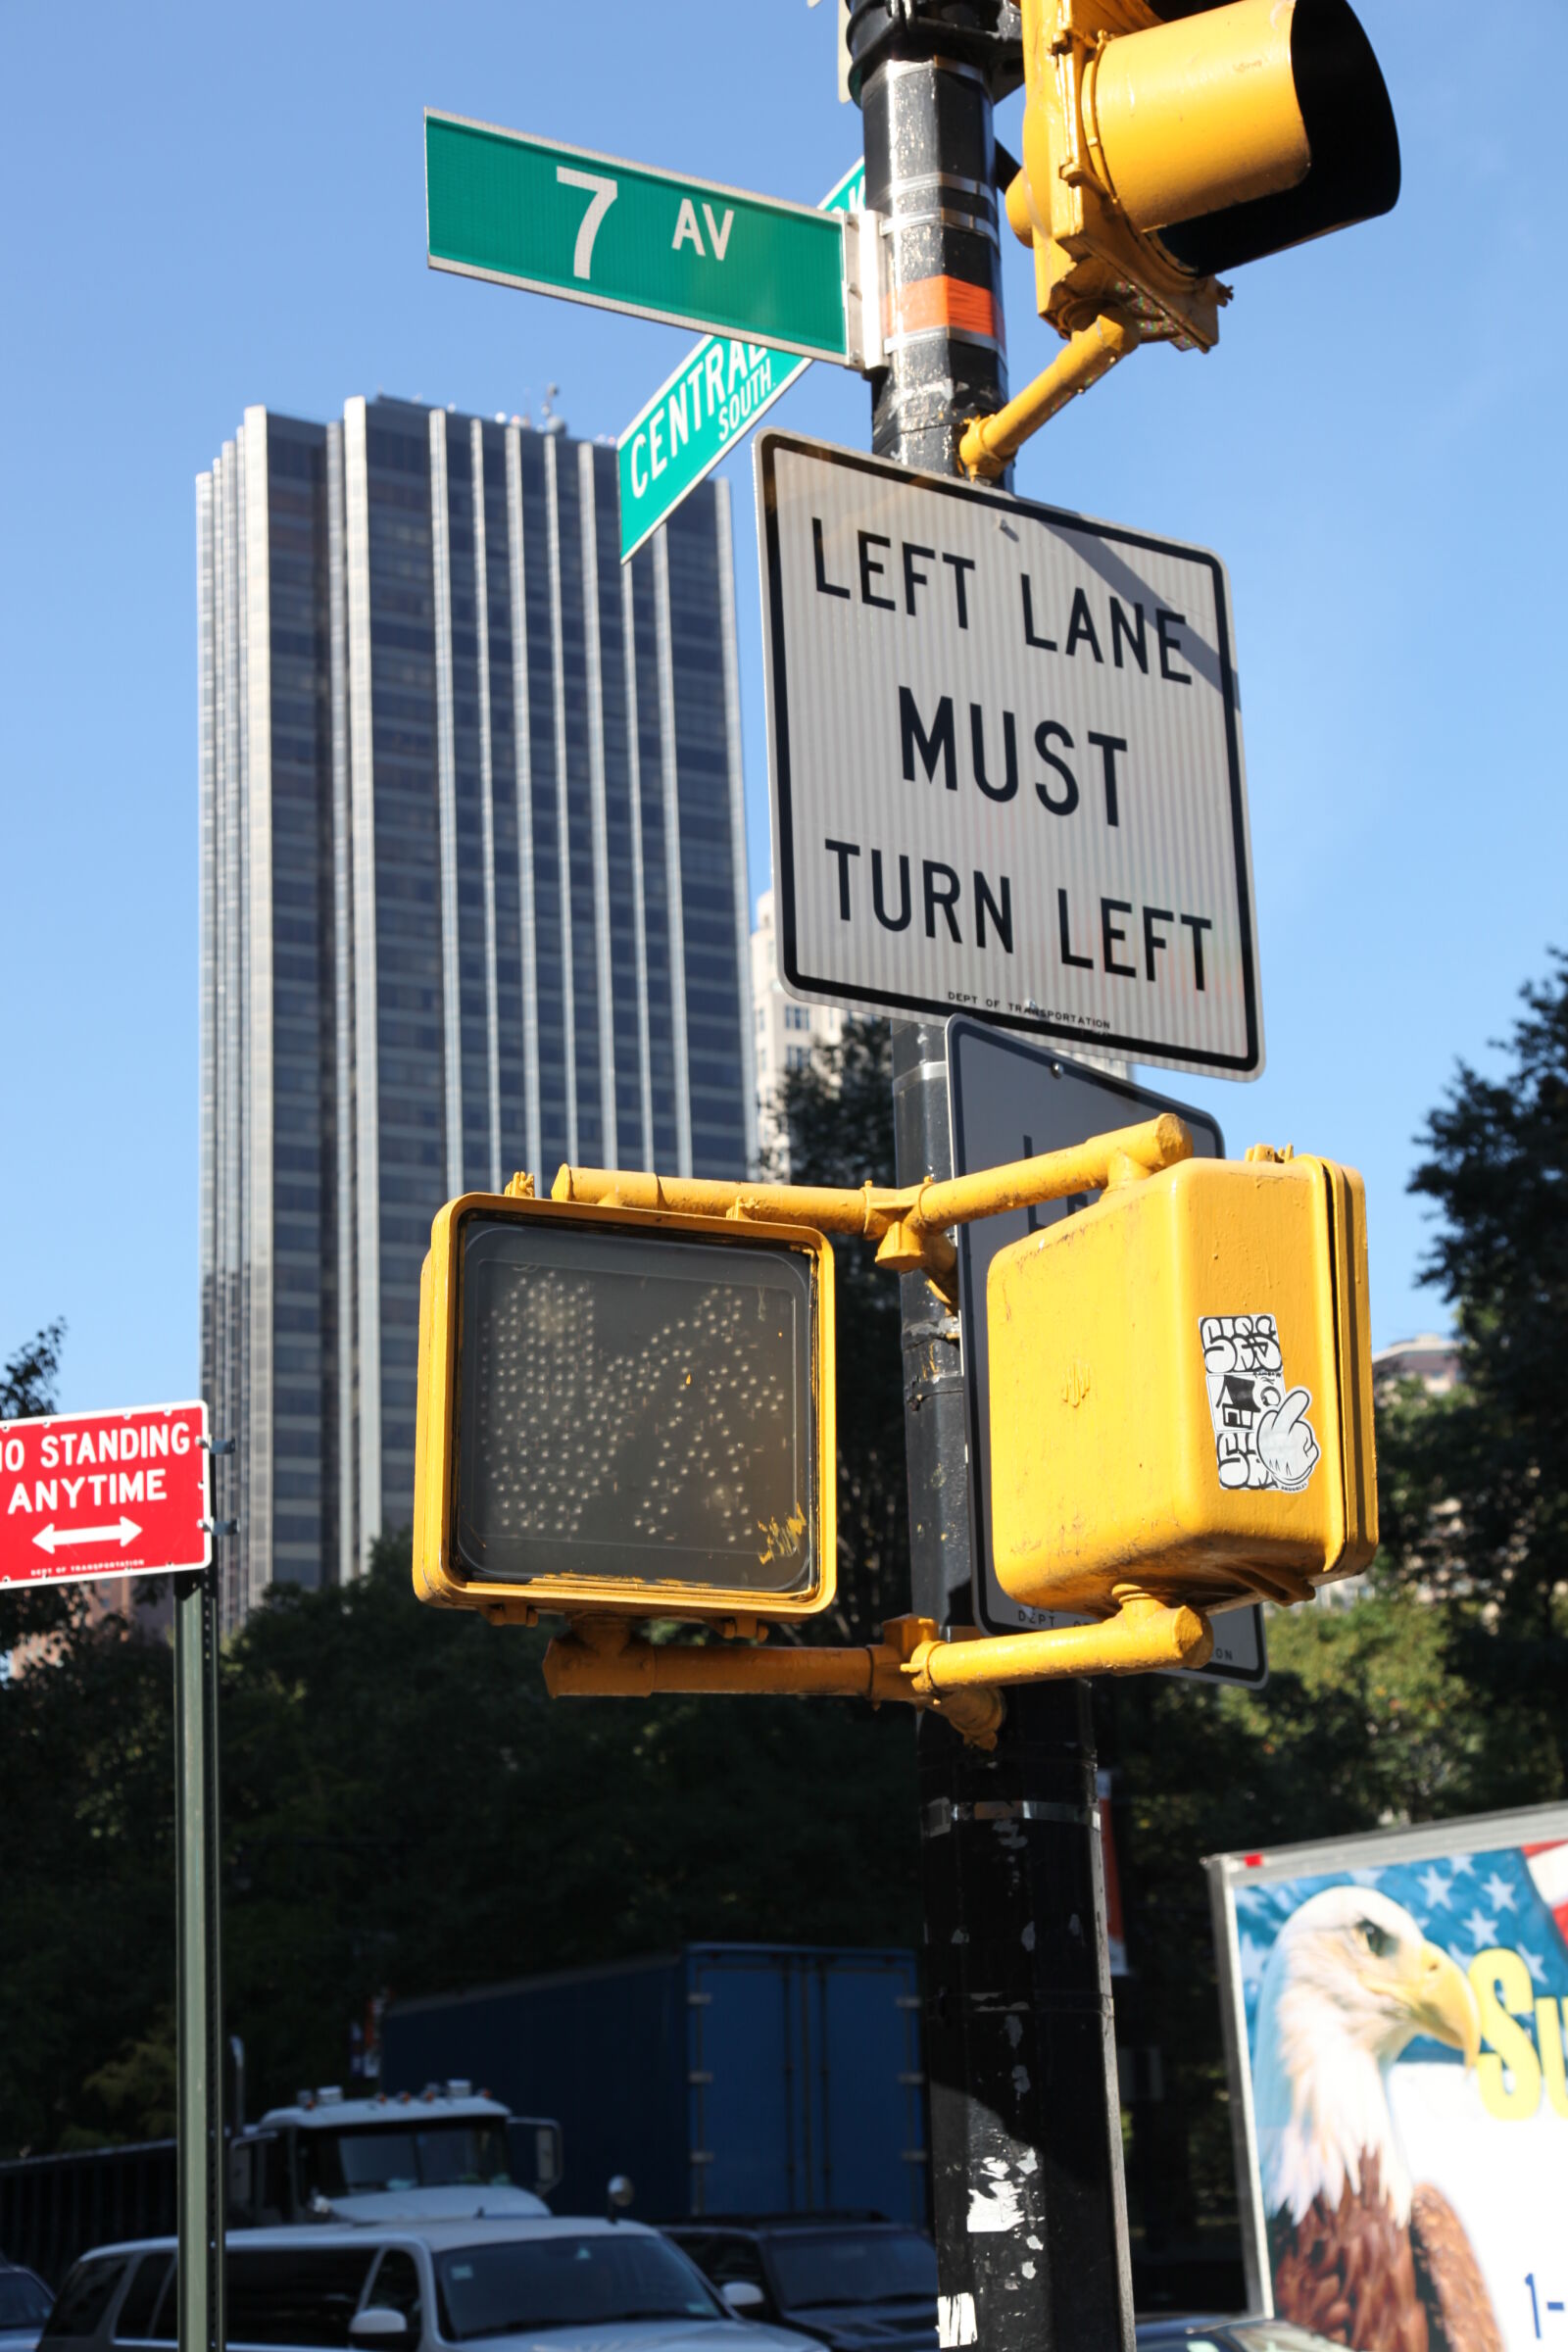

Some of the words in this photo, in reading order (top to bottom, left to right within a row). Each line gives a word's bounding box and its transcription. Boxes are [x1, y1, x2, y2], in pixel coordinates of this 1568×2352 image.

[556, 166, 618, 280] 7
[671, 198, 735, 262] AV
[718, 357, 772, 442] SOUTH
[811, 516, 976, 630] LEFT
[1020, 573, 1193, 685] LANE
[898, 685, 1128, 827] MUST
[824, 838, 1014, 955] TURN
[1057, 888, 1212, 992] LEFT
[948, 991, 978, 1004] DEPT
[985, 998, 1000, 1008] OF
[1008, 1002, 1110, 1029] TRANSPORTATION
[0, 1438, 25, 1473] O
[40, 1422, 191, 1469] STANDING
[7, 1468, 168, 1515] ANYTIME
[1017, 1608, 1055, 1628] DEPT
